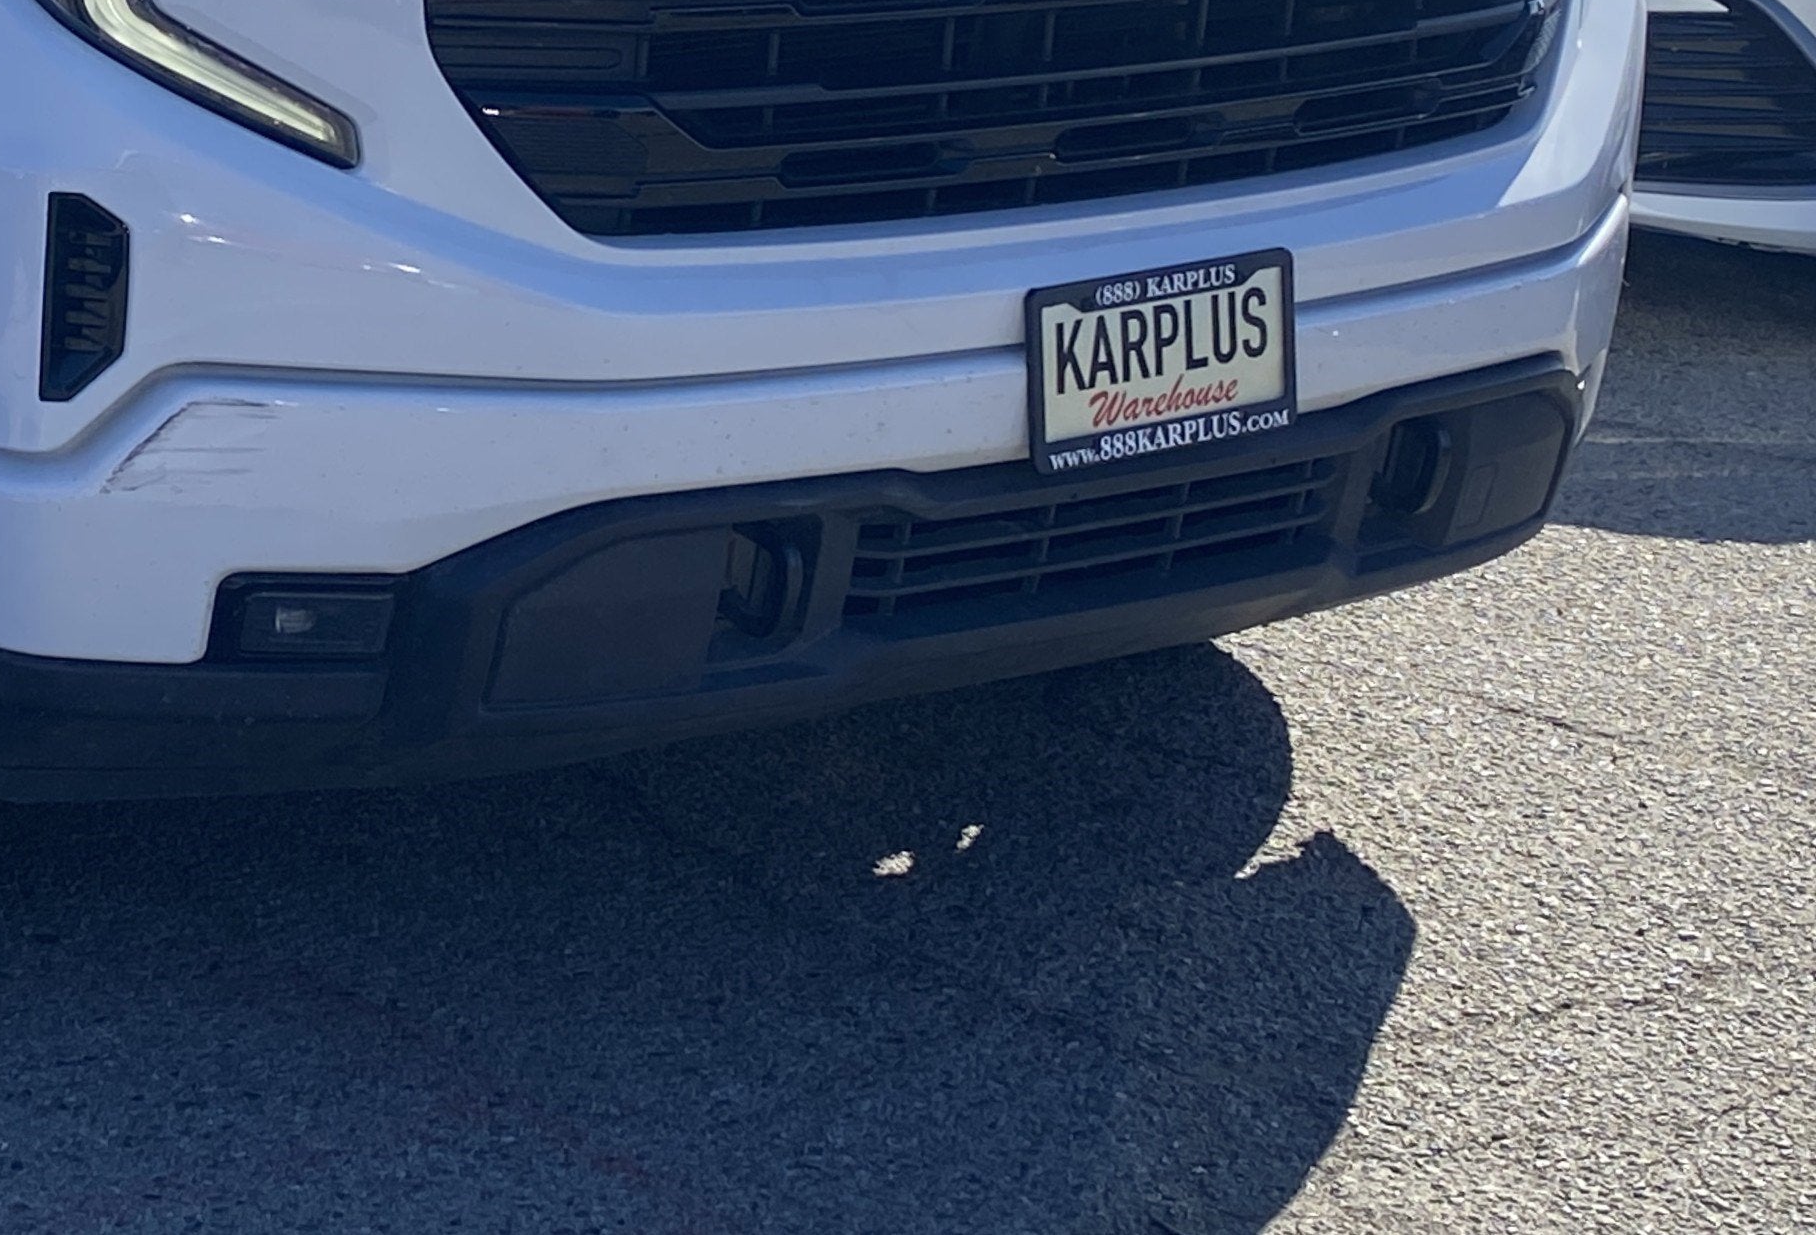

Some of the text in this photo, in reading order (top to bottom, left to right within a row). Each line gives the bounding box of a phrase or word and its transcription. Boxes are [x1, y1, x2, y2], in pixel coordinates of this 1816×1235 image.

[1094, 264, 1235, 306] (888) KARPLUS
[1055, 286, 1269, 395] KARPLUS
[1088, 373, 1239, 428] Warehouse
